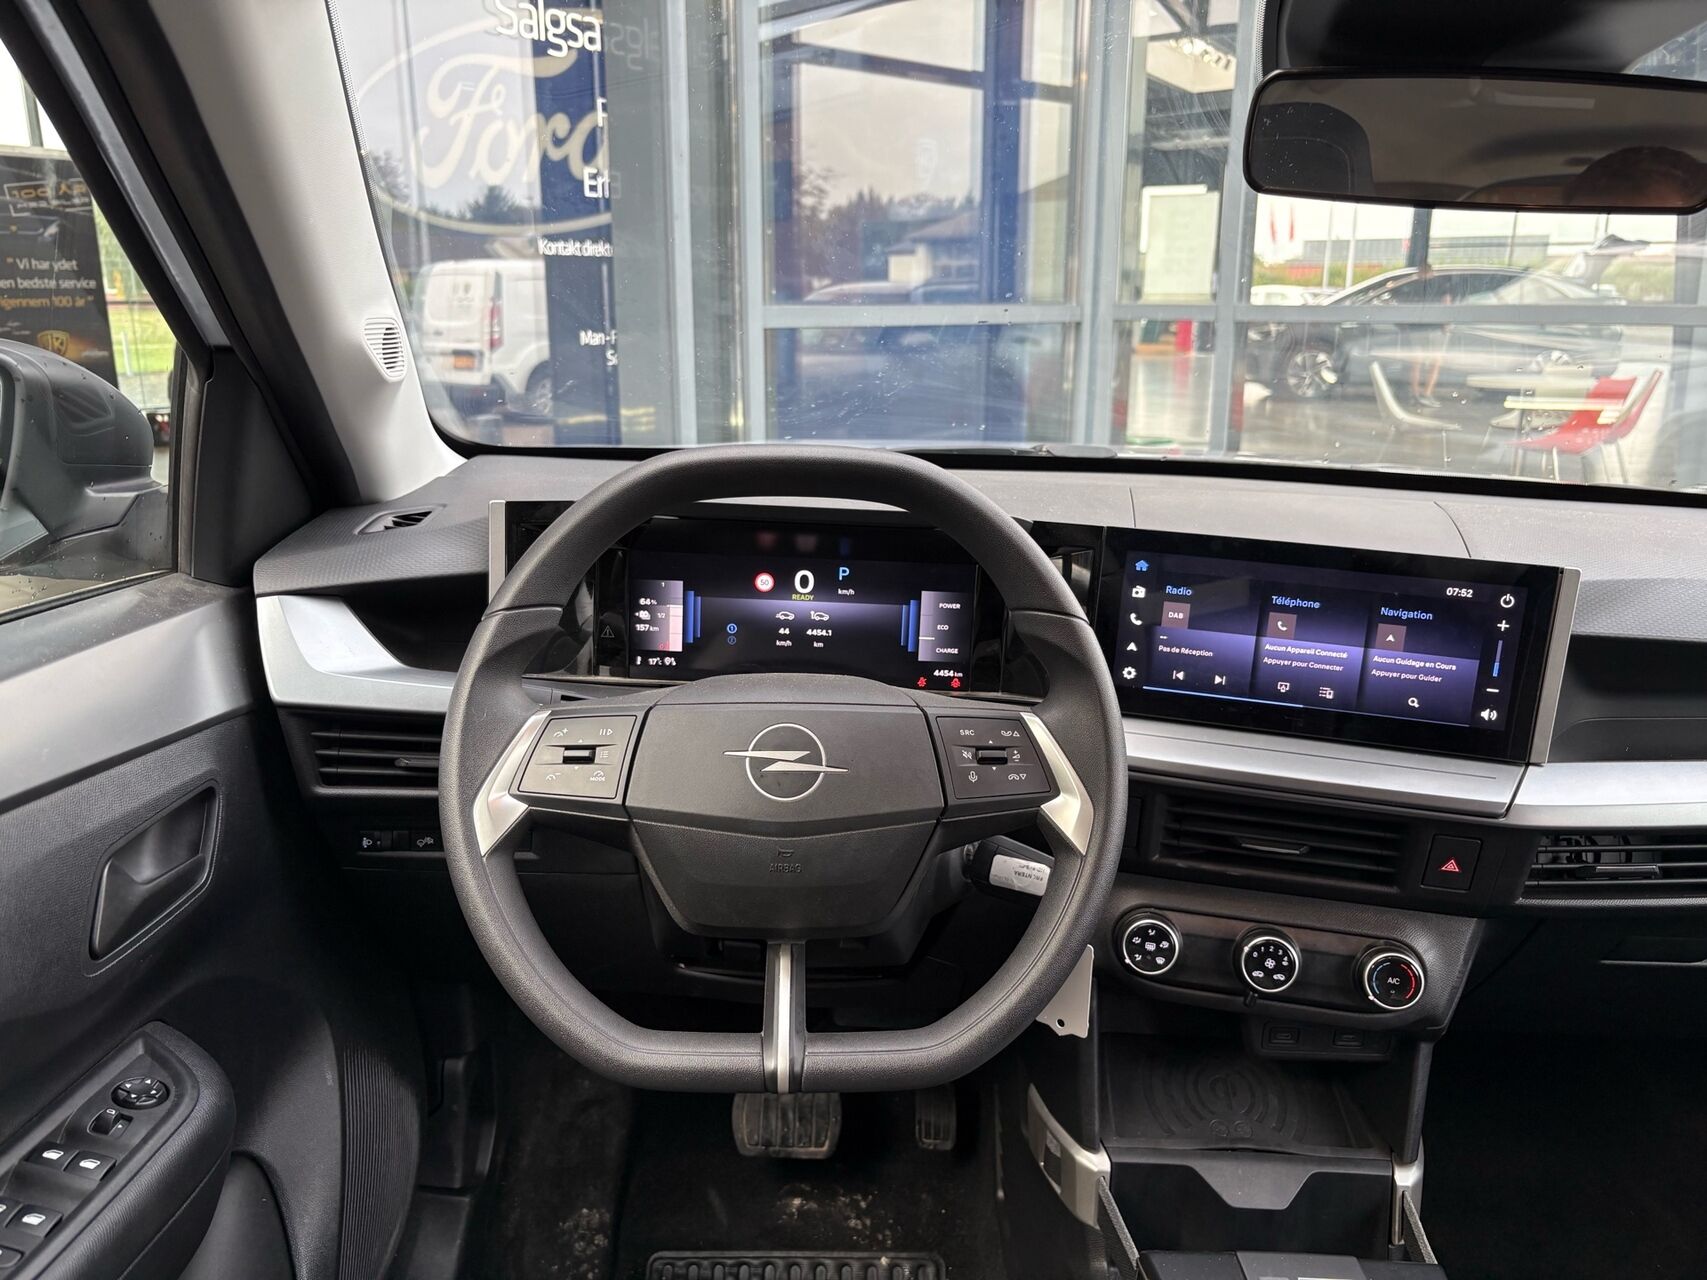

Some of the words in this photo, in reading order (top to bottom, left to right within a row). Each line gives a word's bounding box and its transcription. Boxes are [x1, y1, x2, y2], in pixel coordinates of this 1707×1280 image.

[495, 0, 602, 57] Salgsa
[537, 237, 581, 256] Kontakt
[16, 257, 30, 270] Vi
[31, 257, 50, 270] har
[52, 258, 79, 272] ydet
[17, 277, 57, 289] bedste
[59, 277, 97, 289] service
[52, 295, 73, 307] 100
[605, 349, 618, 366] S
[838, 566, 850, 581] P
[759, 578, 770, 587] 50
[794, 569, 815, 593] 0
[838, 588, 855, 596] km/h
[1165, 585, 1193, 597] Radio
[1446, 587, 1474, 598] 07:52
[938, 602, 961, 610] POWER
[1271, 595, 1321, 610] Téléphone
[1168, 611, 1184, 619] DAB
[1380, 607, 1434, 621] Navigation
[778, 627, 790, 635] 44
[806, 629, 832, 637] 4454.1
[1158, 645, 1170, 653] Pas
[1181, 647, 1213, 657] Réception
[1264, 643, 1286, 652] Aucun
[1286, 645, 1315, 656] Appareil
[1315, 649, 1348, 659] Connecté
[1263, 656, 1291, 667] Appuyer
[1292, 660, 1308, 669] pour
[1308, 662, 1344, 672] Connecter
[1373, 655, 1395, 664] Aucun
[1395, 658, 1425, 669] Guidage
[1425, 661, 1435, 669] en
[1435, 662, 1457, 671] Cours
[1371, 668, 1400, 679] Appuyer
[1401, 672, 1417, 681] pour
[1418, 674, 1442, 682] Guider
[769, 863, 802, 873] AIRBAG
[1387, 976, 1401, 985] A/C
